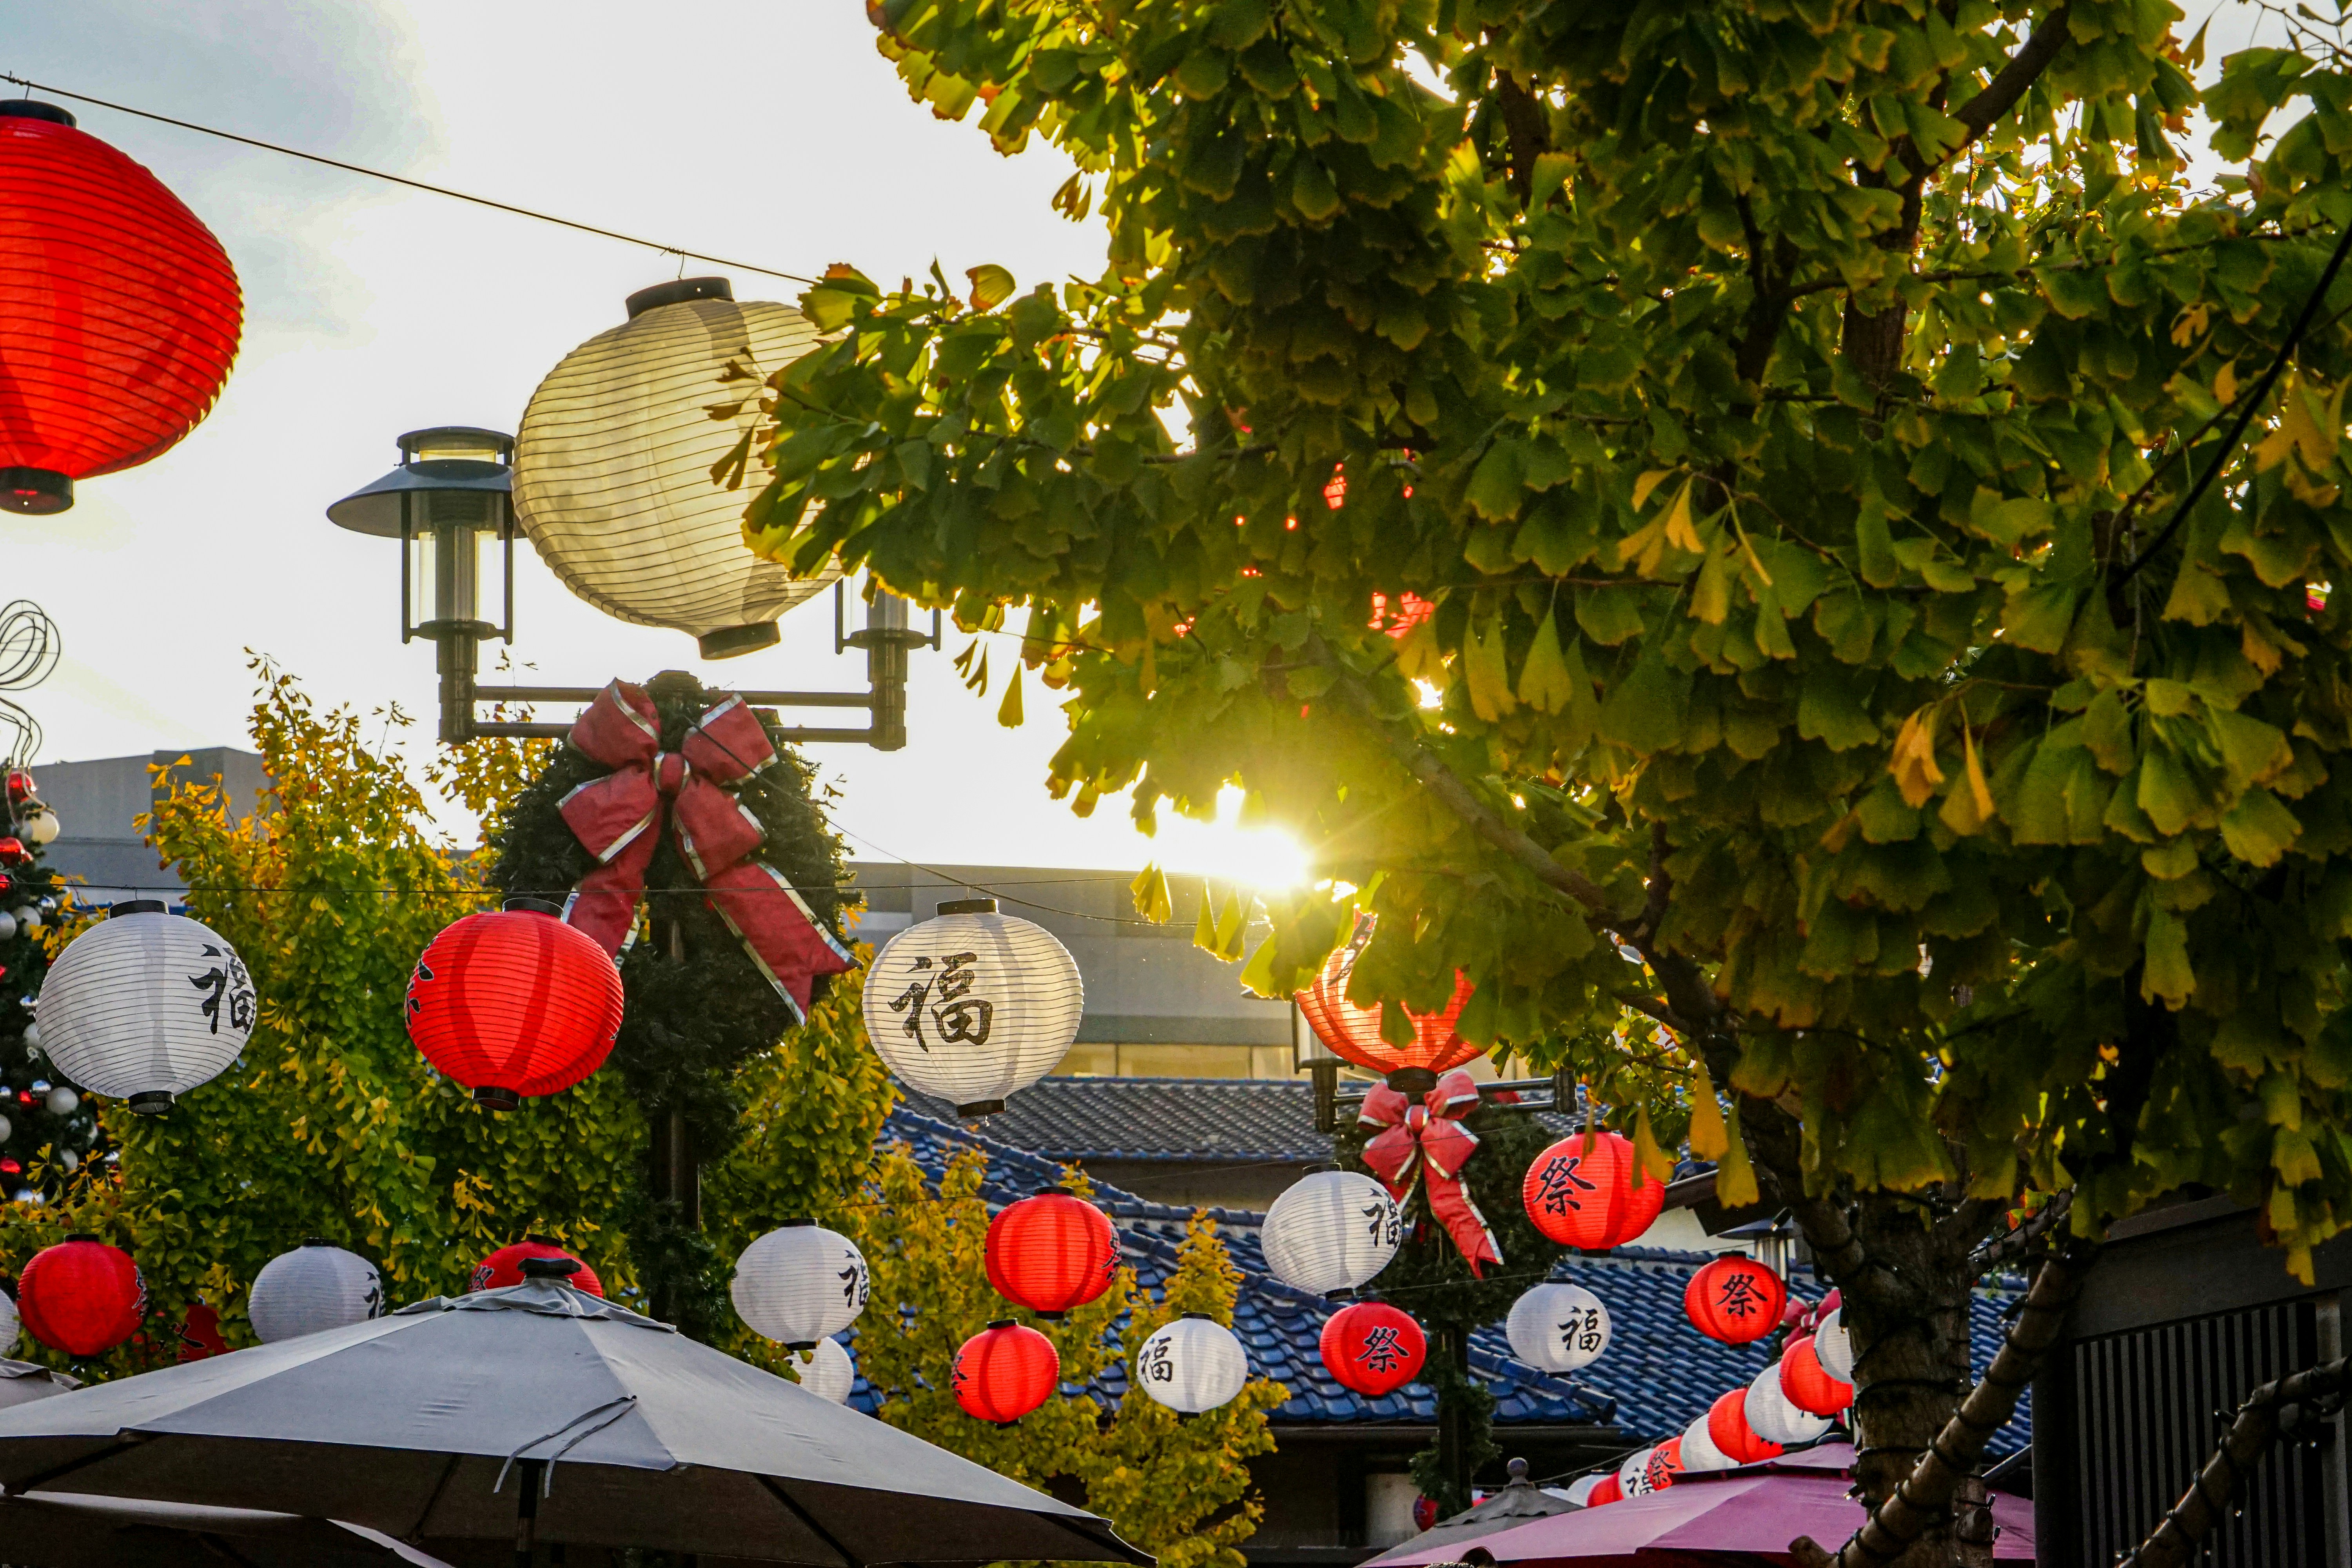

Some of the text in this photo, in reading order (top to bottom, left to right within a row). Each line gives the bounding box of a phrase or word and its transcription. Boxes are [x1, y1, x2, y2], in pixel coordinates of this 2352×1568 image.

[188, 944, 256, 1035] 福
[887, 952, 993, 1053] 福
[1533, 1156, 1597, 1216] 祭
[1361, 1188, 1401, 1249] 福
[1715, 1273, 1768, 1318] 祭
[1356, 1326, 1409, 1374] 祭
[1558, 1305, 1602, 1352] 福
[1140, 1336, 1173, 1384] 福
[1649, 1450, 1676, 1486] 祭
